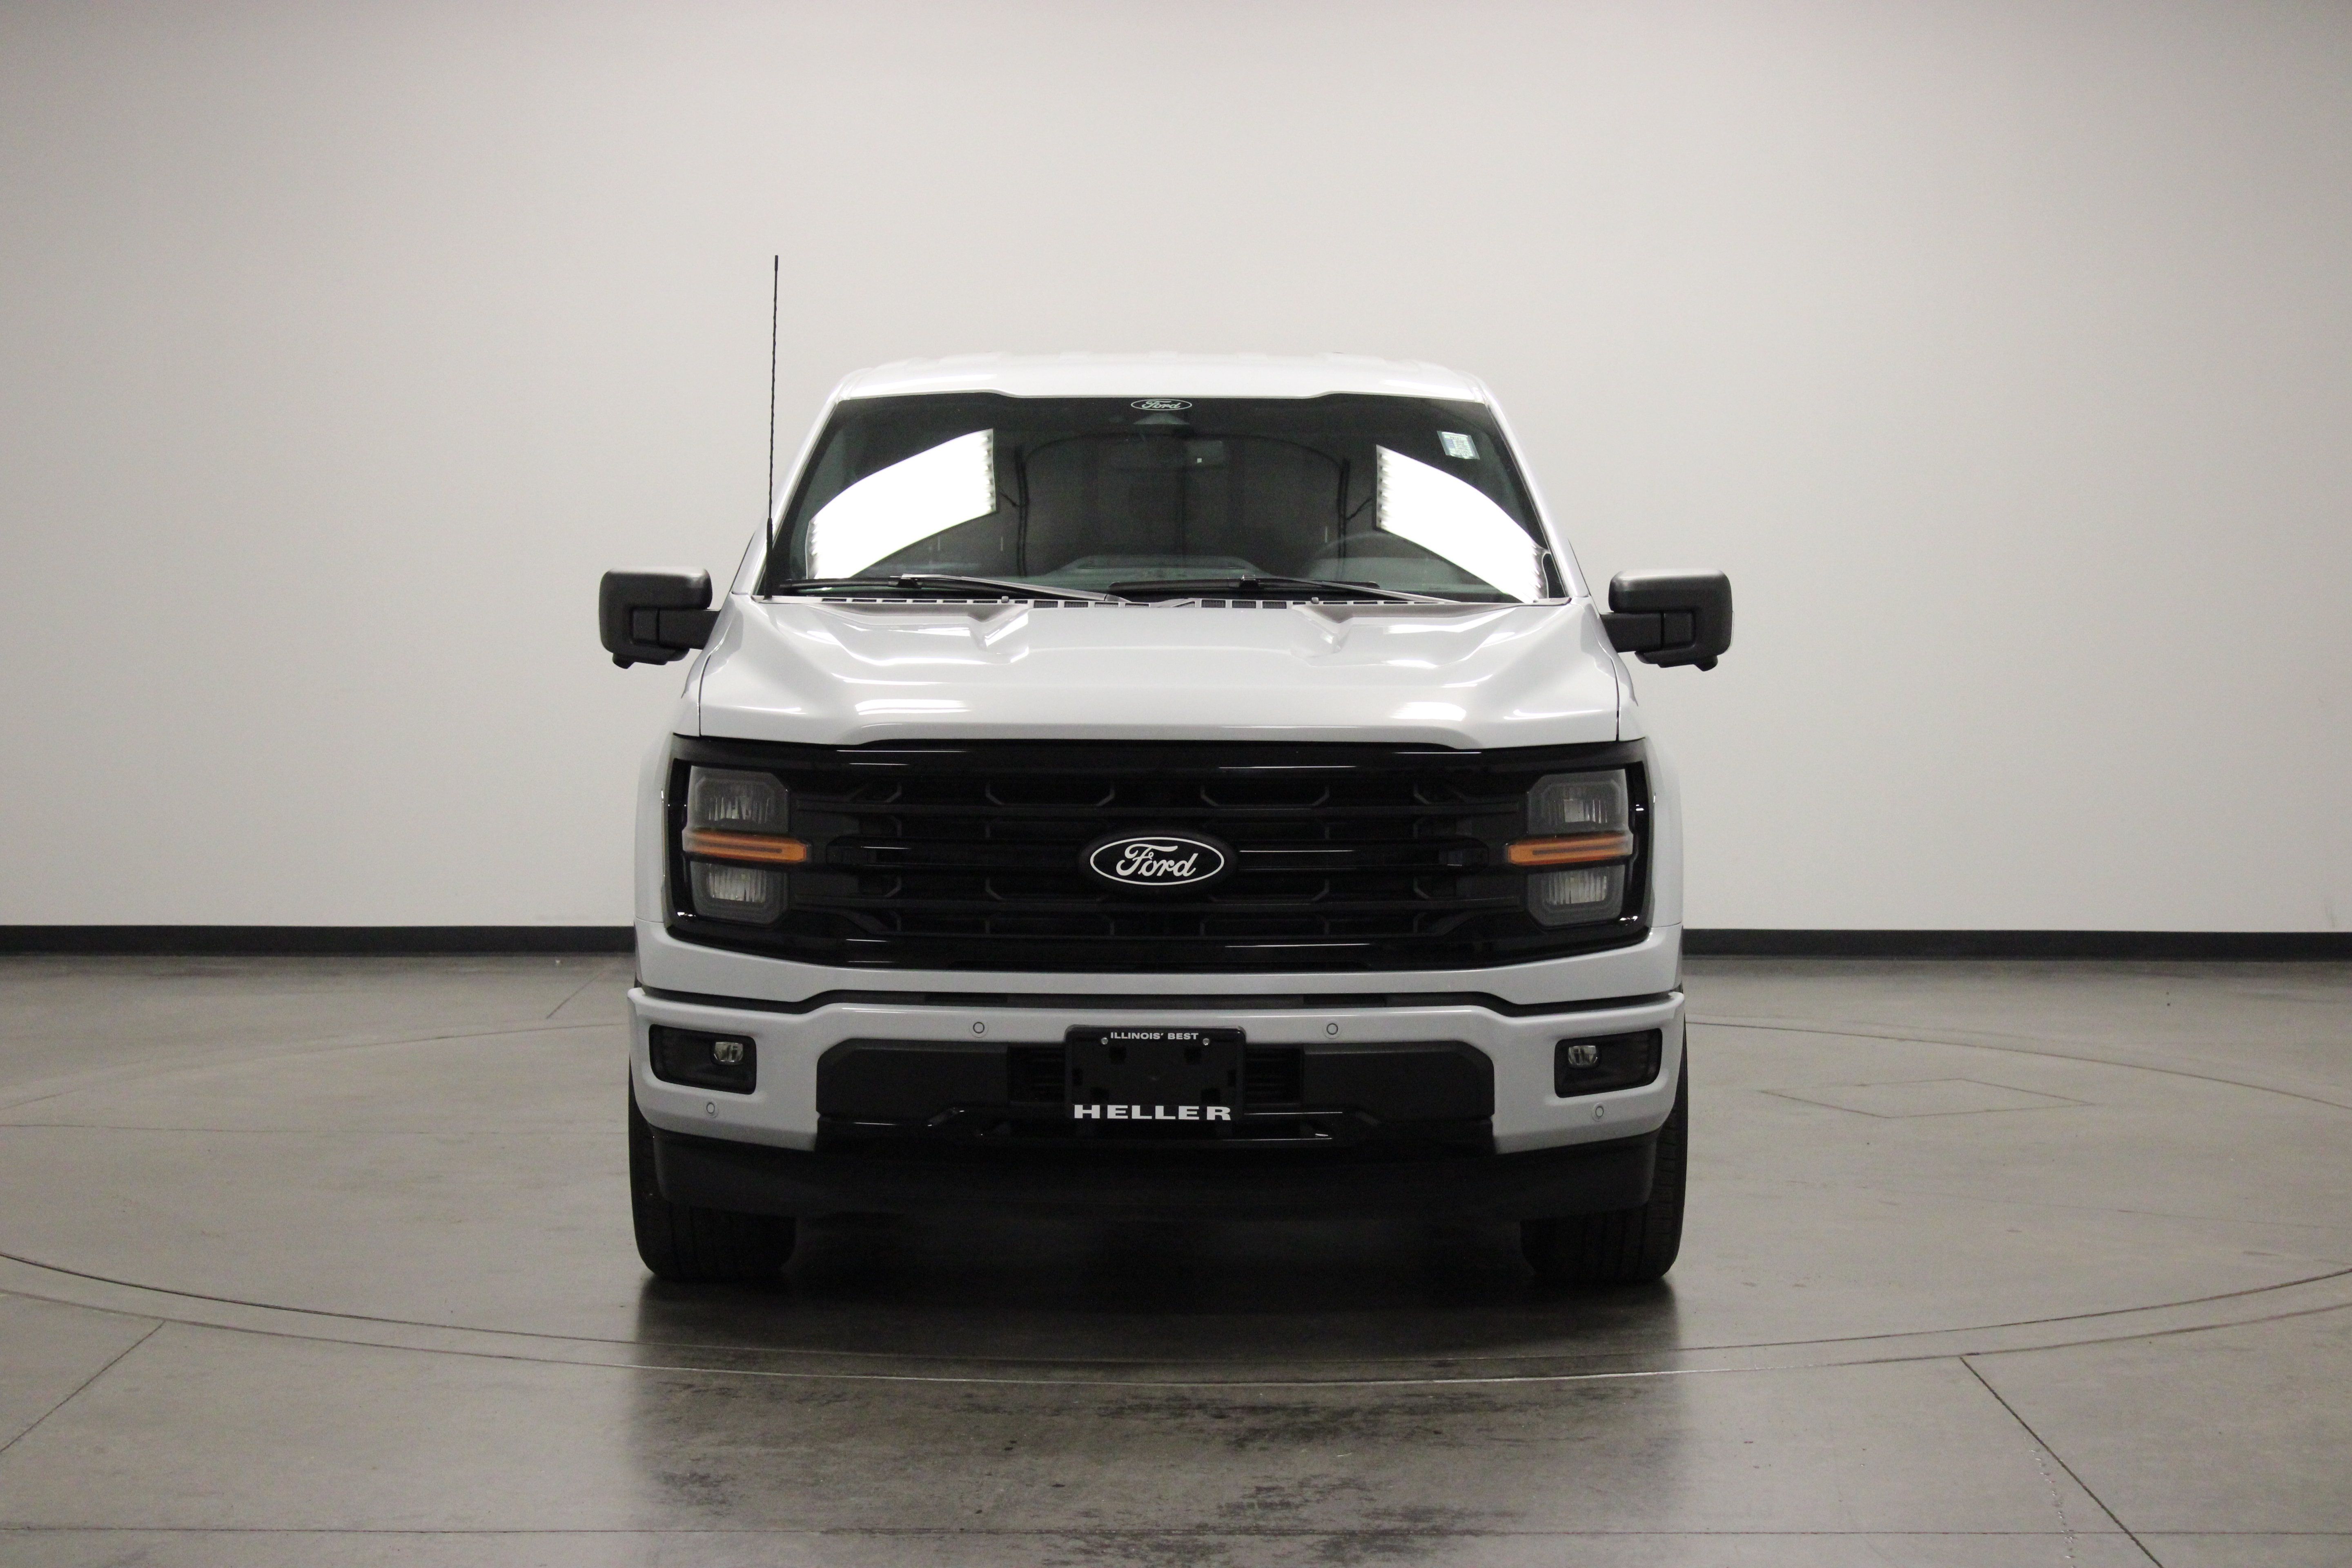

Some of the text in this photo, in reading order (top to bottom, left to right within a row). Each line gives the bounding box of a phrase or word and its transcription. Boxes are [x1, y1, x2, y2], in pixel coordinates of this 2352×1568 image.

[1142, 401, 1181, 409] Ford
[1116, 844, 1198, 876] Ford
[1074, 1105, 1231, 1120] HELLER
